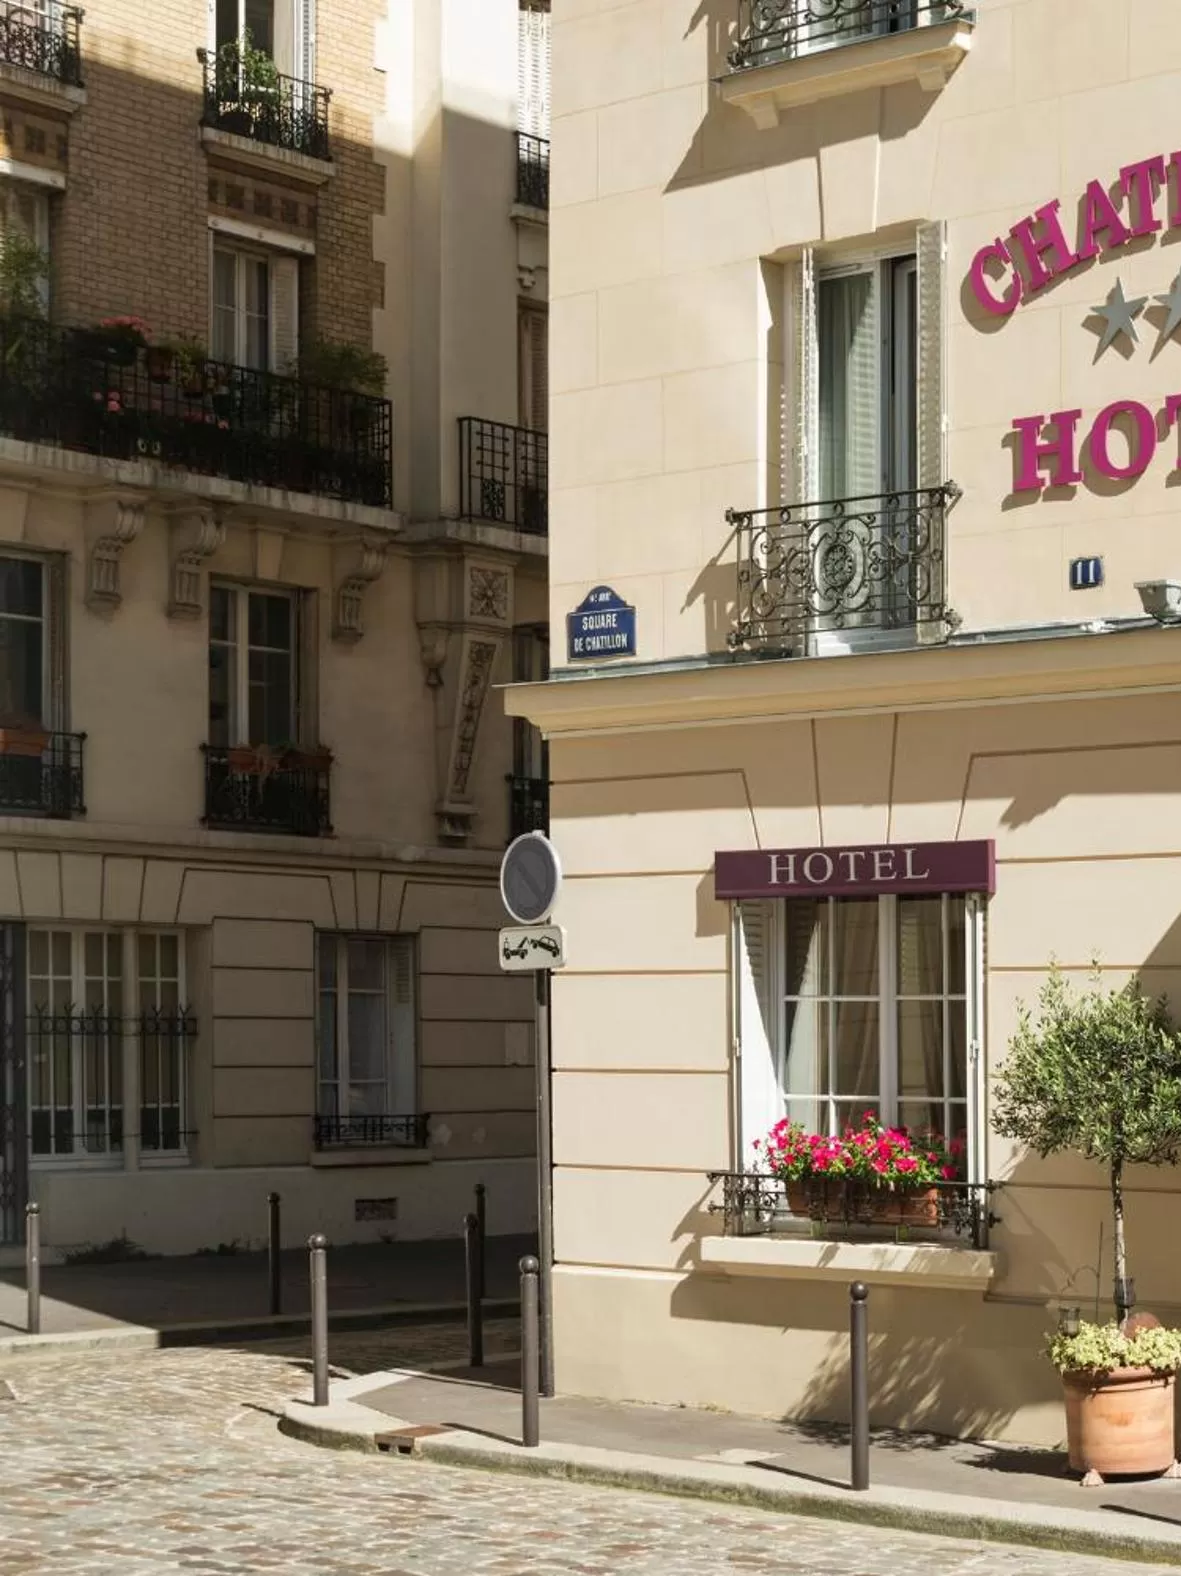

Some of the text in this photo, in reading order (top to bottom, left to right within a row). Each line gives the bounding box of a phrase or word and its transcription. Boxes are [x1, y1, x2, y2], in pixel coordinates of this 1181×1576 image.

[1077, 560, 1095, 584] 11
[582, 613, 617, 630] SQUARE
[574, 633, 627, 652] DE CHATILLON
[768, 848, 930, 884] HOTEL
